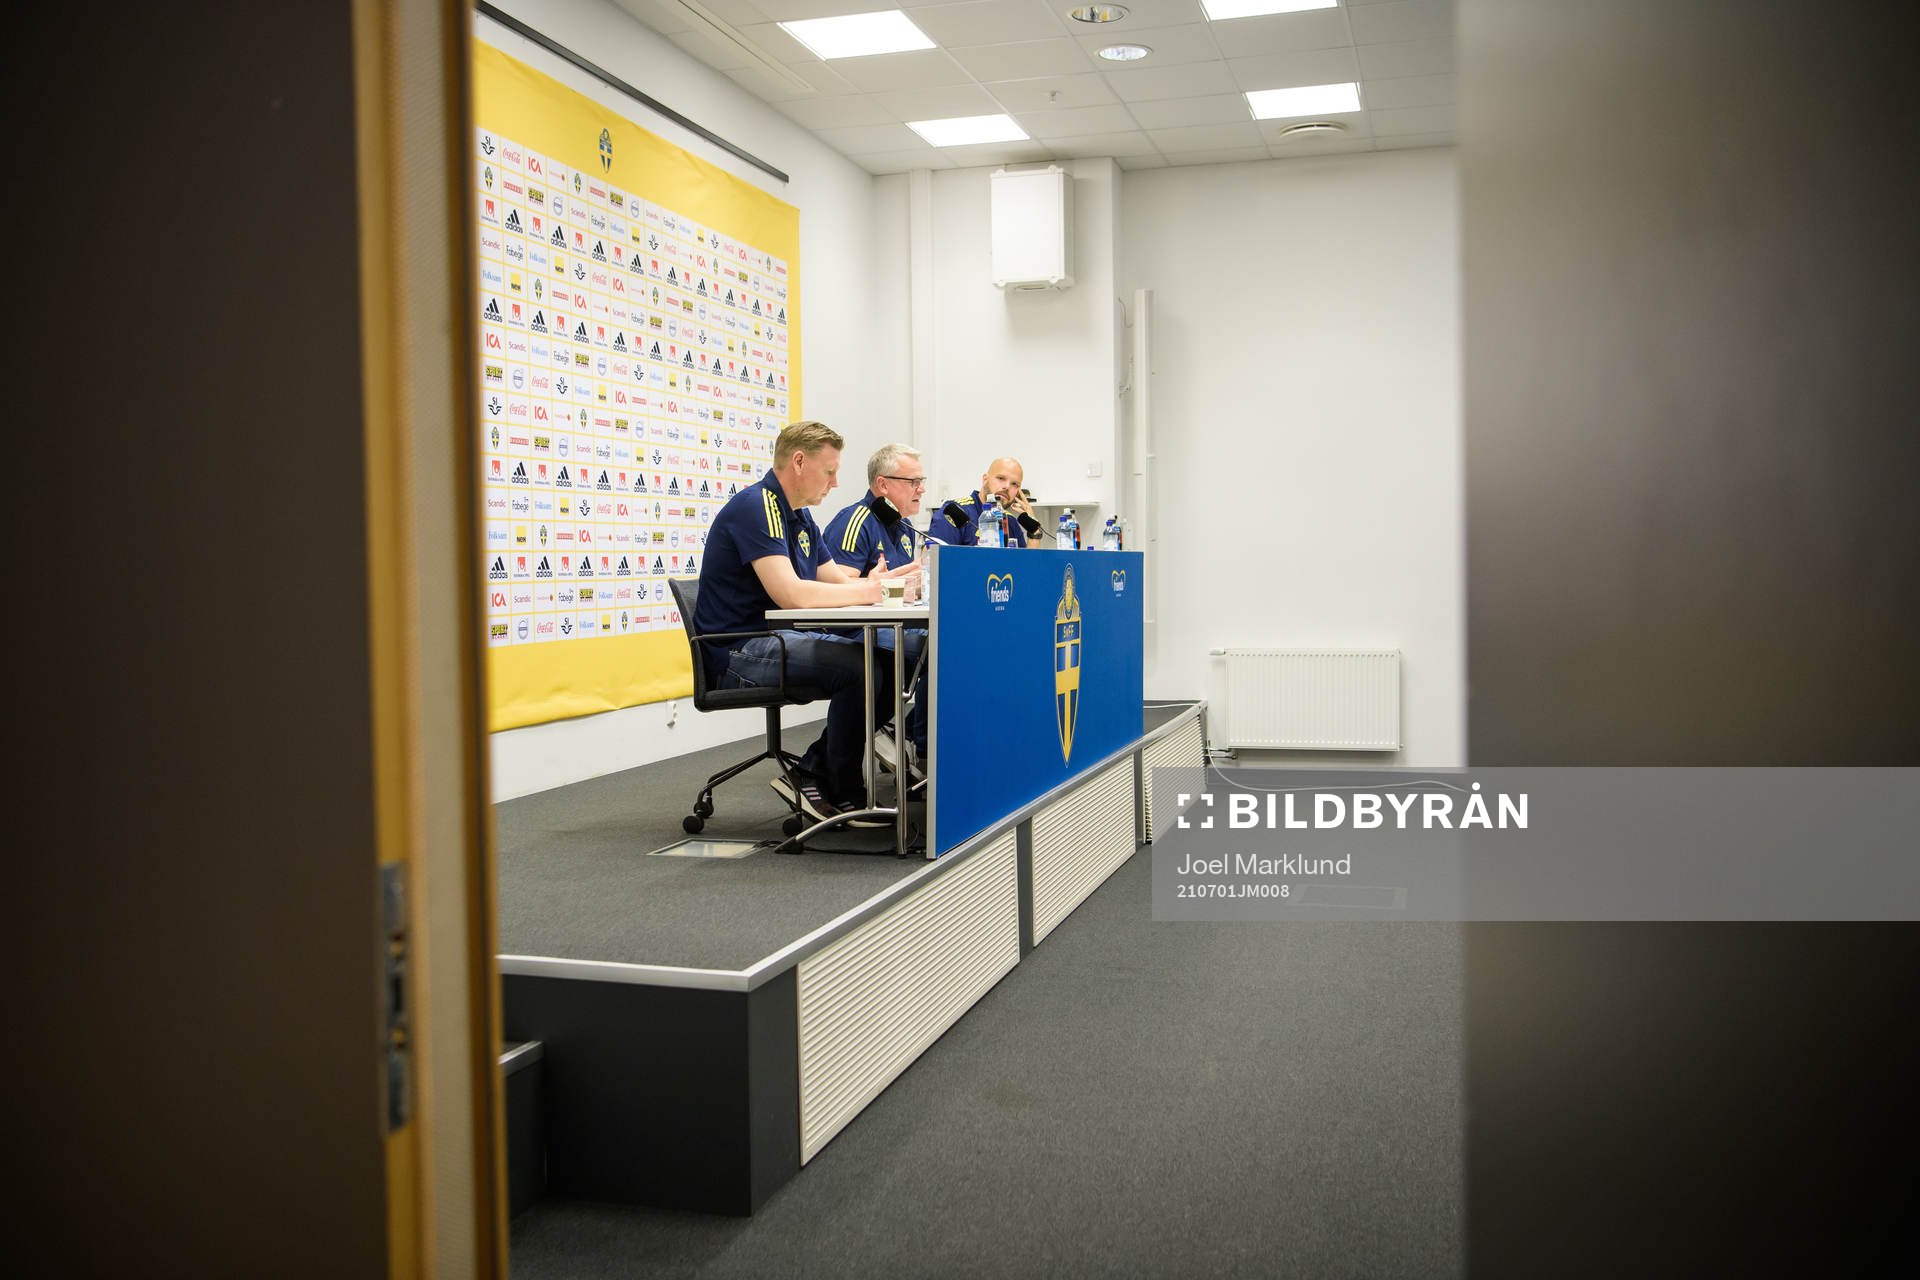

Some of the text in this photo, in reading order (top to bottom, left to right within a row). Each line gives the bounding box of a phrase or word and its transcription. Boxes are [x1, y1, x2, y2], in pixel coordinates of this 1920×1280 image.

[528, 157, 542, 175] ICA
[570, 208, 586, 219] Scandic
[505, 223, 523, 233] adidas
[482, 238, 500, 249] Scandic
[551, 239, 567, 248] adidas
[506, 245, 523, 261] Fabege
[592, 253, 606, 262] adidas
[697, 256, 706, 268] ICA
[630, 266, 644, 275] adidas
[613, 278, 624, 292] ICA
[667, 278, 678, 286] adidas
[574, 294, 586, 310] ICA
[484, 313, 502, 322] adidas
[531, 324, 547, 333] adidas
[486, 333, 501, 350] ICA
[574, 335, 589, 343] adidas
[508, 342, 526, 351] Scandic
[613, 344, 627, 352] adidas
[554, 351, 569, 365] Fabege
[616, 391, 627, 404] ICA
[714, 386, 722, 398] ICA
[534, 406, 548, 420] ICA
[668, 401, 678, 414] ICA
[700, 458, 709, 469] ICA
[488, 499, 505, 507] Scandic
[512, 500, 528, 512] Fabege
[617, 504, 628, 516] ICA
[579, 529, 591, 543] ICA
[559, 592, 573, 604] Fabege
[990, 582, 1009, 604] friends
[492, 593, 506, 607] ICA
[671, 612, 680, 623] ICA
[491, 624, 508, 636] SPORT
